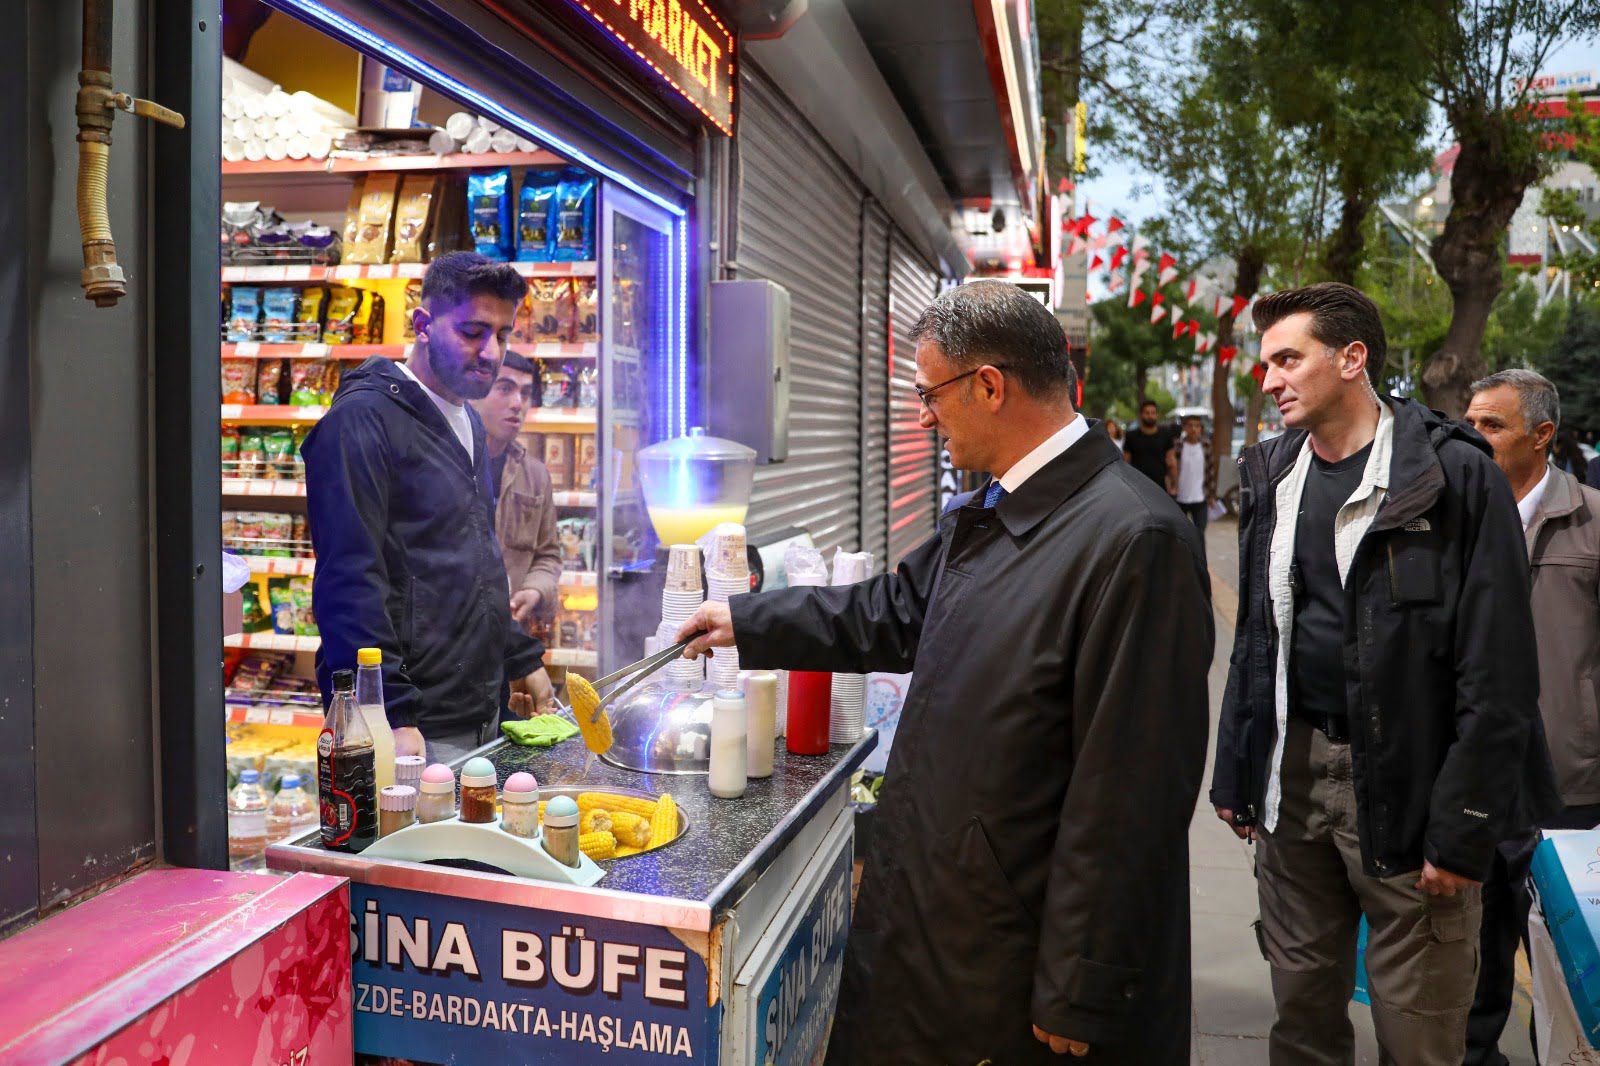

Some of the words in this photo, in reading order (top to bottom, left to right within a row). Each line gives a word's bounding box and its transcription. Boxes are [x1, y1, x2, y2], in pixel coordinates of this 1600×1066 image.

[351, 900, 480, 976] İNA
[502, 926, 686, 1003] BÜFE
[810, 872, 845, 985] BÜFE
[351, 982, 694, 1059] ZDE-BARDAKTA-HAŞLAMA
